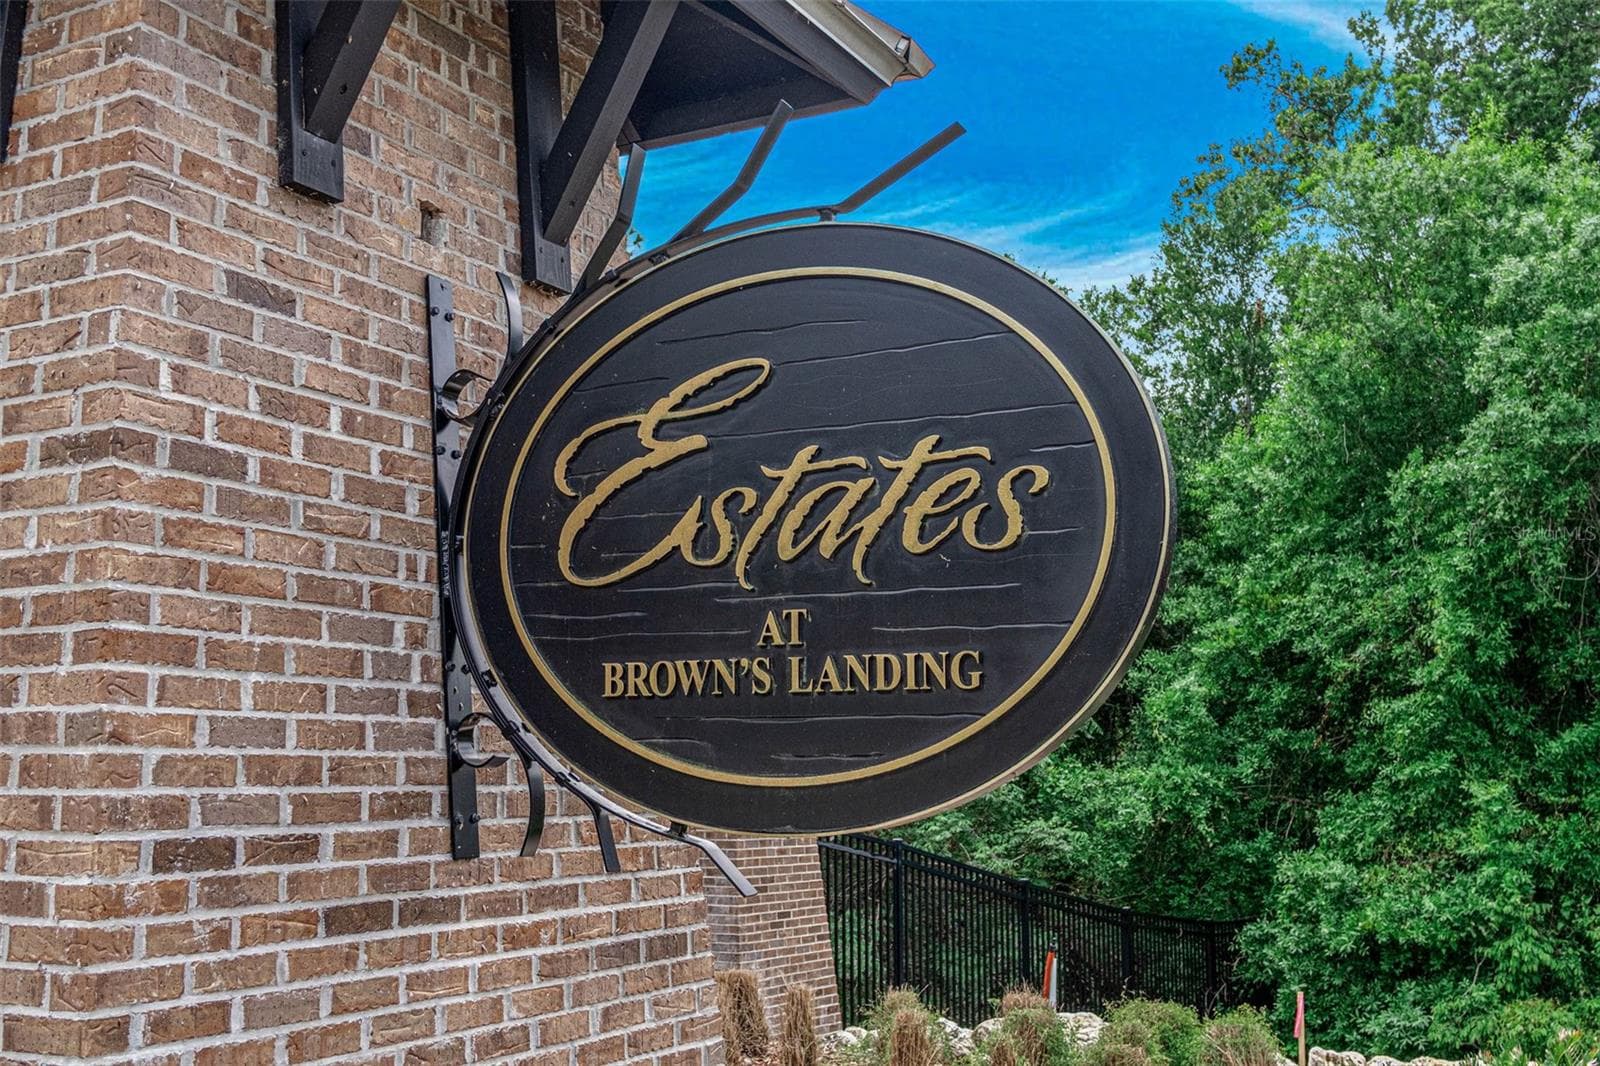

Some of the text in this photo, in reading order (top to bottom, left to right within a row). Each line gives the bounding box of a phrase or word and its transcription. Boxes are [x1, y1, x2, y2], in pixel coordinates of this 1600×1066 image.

[554, 357, 1050, 590] Estates
[756, 608, 809, 646] AT
[602, 650, 983, 697] BROWN'S LANDING
